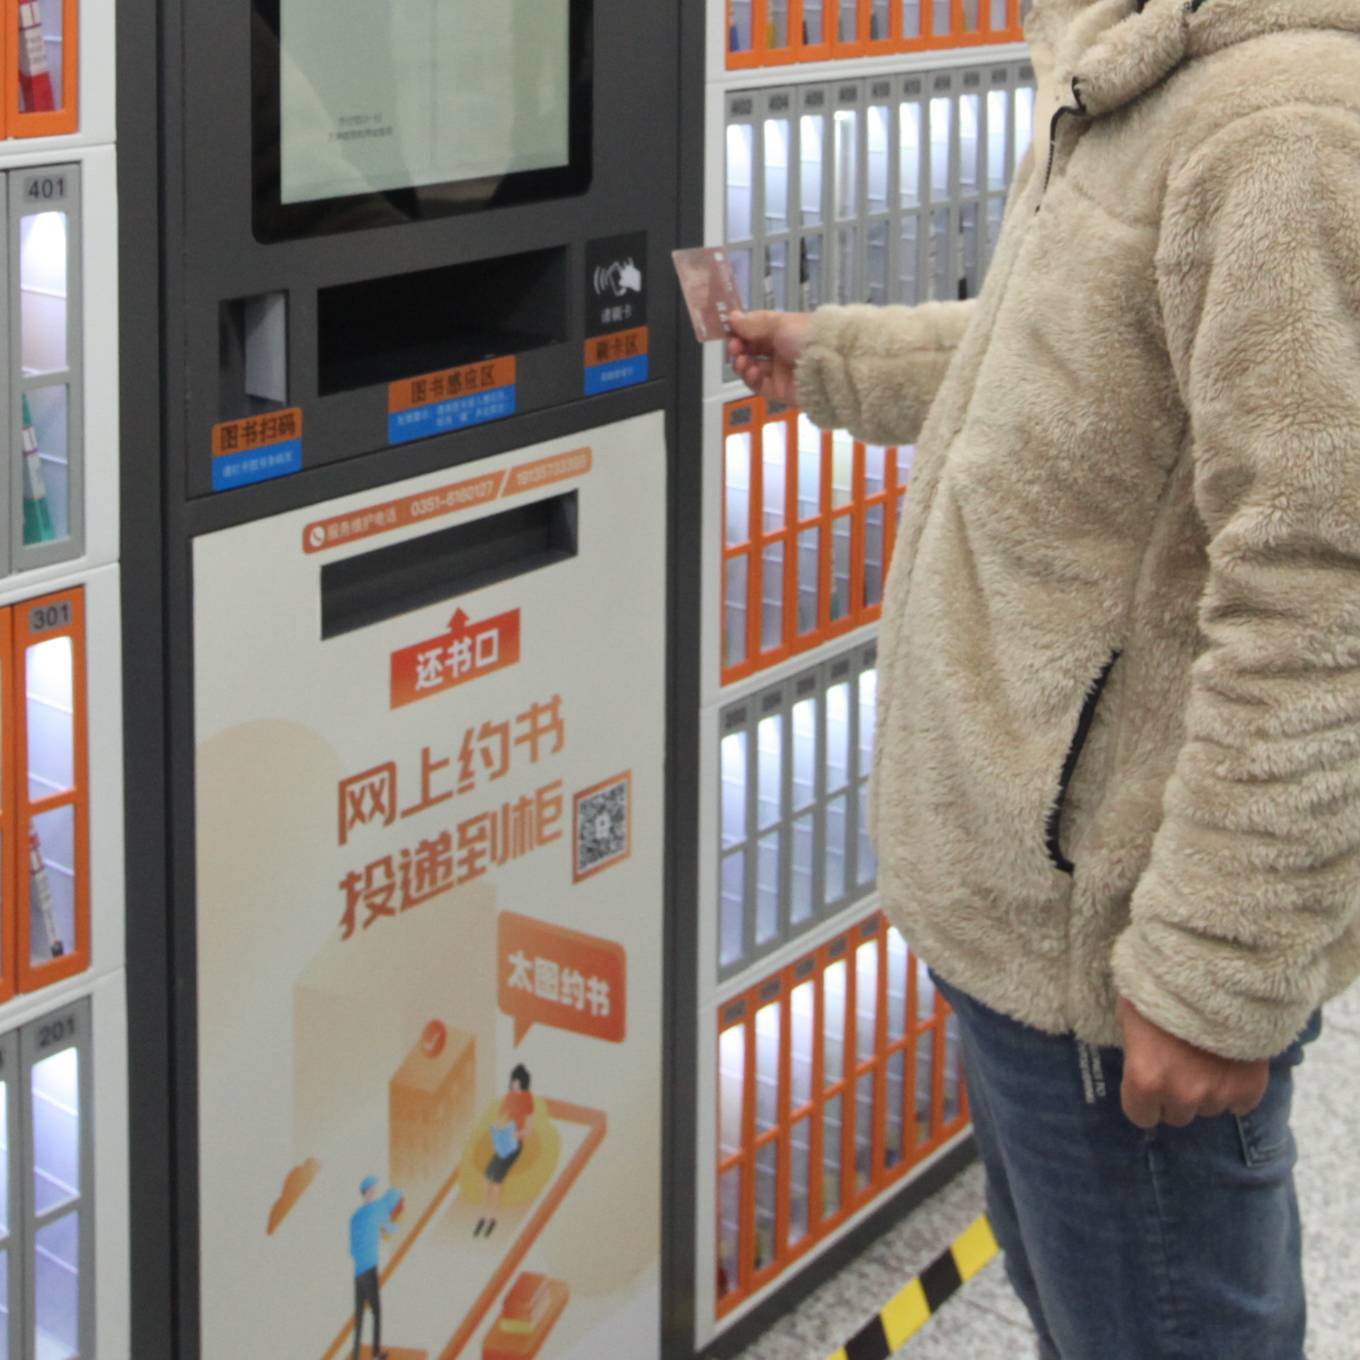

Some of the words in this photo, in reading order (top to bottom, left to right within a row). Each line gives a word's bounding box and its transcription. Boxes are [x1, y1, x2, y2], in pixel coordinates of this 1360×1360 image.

[28, 178, 66, 200] 401
[594, 332, 640, 361] 刷卡区
[410, 363, 497, 404] 图书感应区
[220, 414, 296, 451] 图书扫码
[327, 507, 397, 542] 服务维护电话
[34, 604, 71, 631] 301
[415, 628, 500, 691] 还书口
[338, 693, 566, 846] 网上约书
[338, 778, 563, 942] 投递到柜
[506, 950, 612, 1017] 太图约书
[39, 1019, 76, 1046] 201
